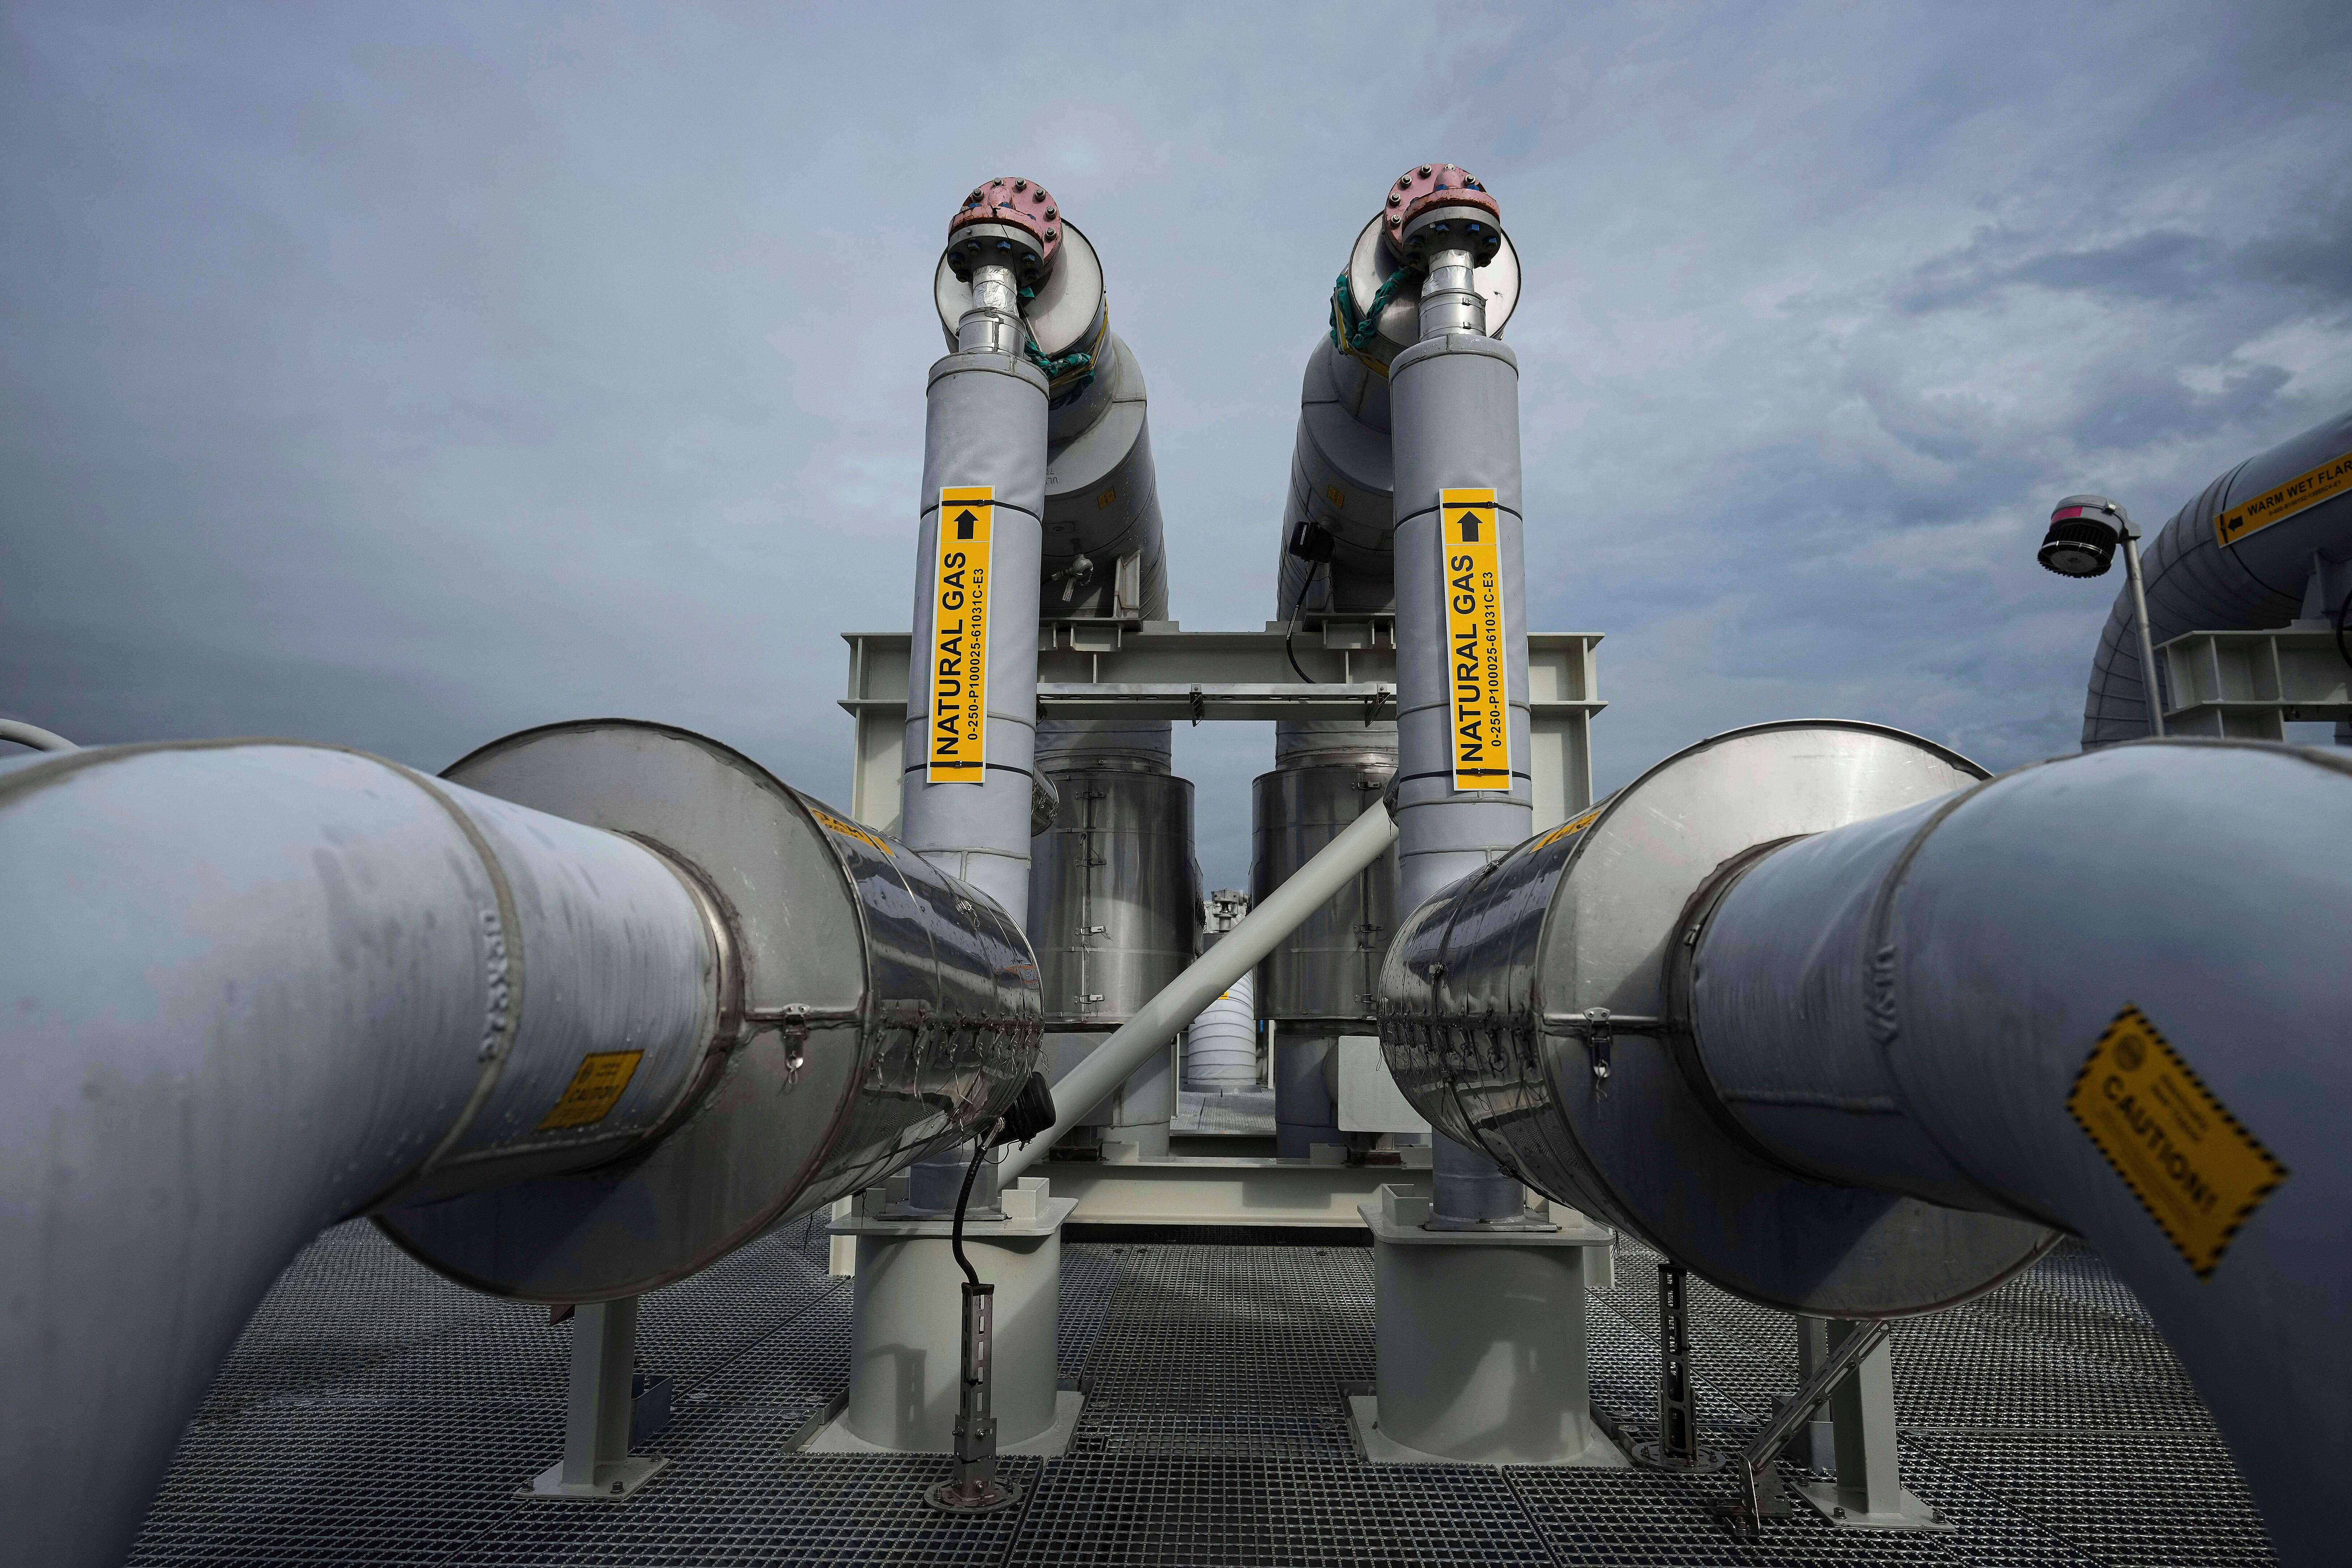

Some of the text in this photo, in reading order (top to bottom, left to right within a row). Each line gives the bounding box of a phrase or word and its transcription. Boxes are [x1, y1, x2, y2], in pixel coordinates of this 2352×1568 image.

[2247, 491, 2284, 517] WARM
[2287, 478, 2313, 499] WET
[936, 552, 966, 755] NATURAL GAS
[968, 569, 983, 740] 0-250-P100025-61031C-E3
[1451, 555, 1483, 761] NATURAL GAS
[1482, 572, 1501, 747] 0-250-P100025-61031C-E3
